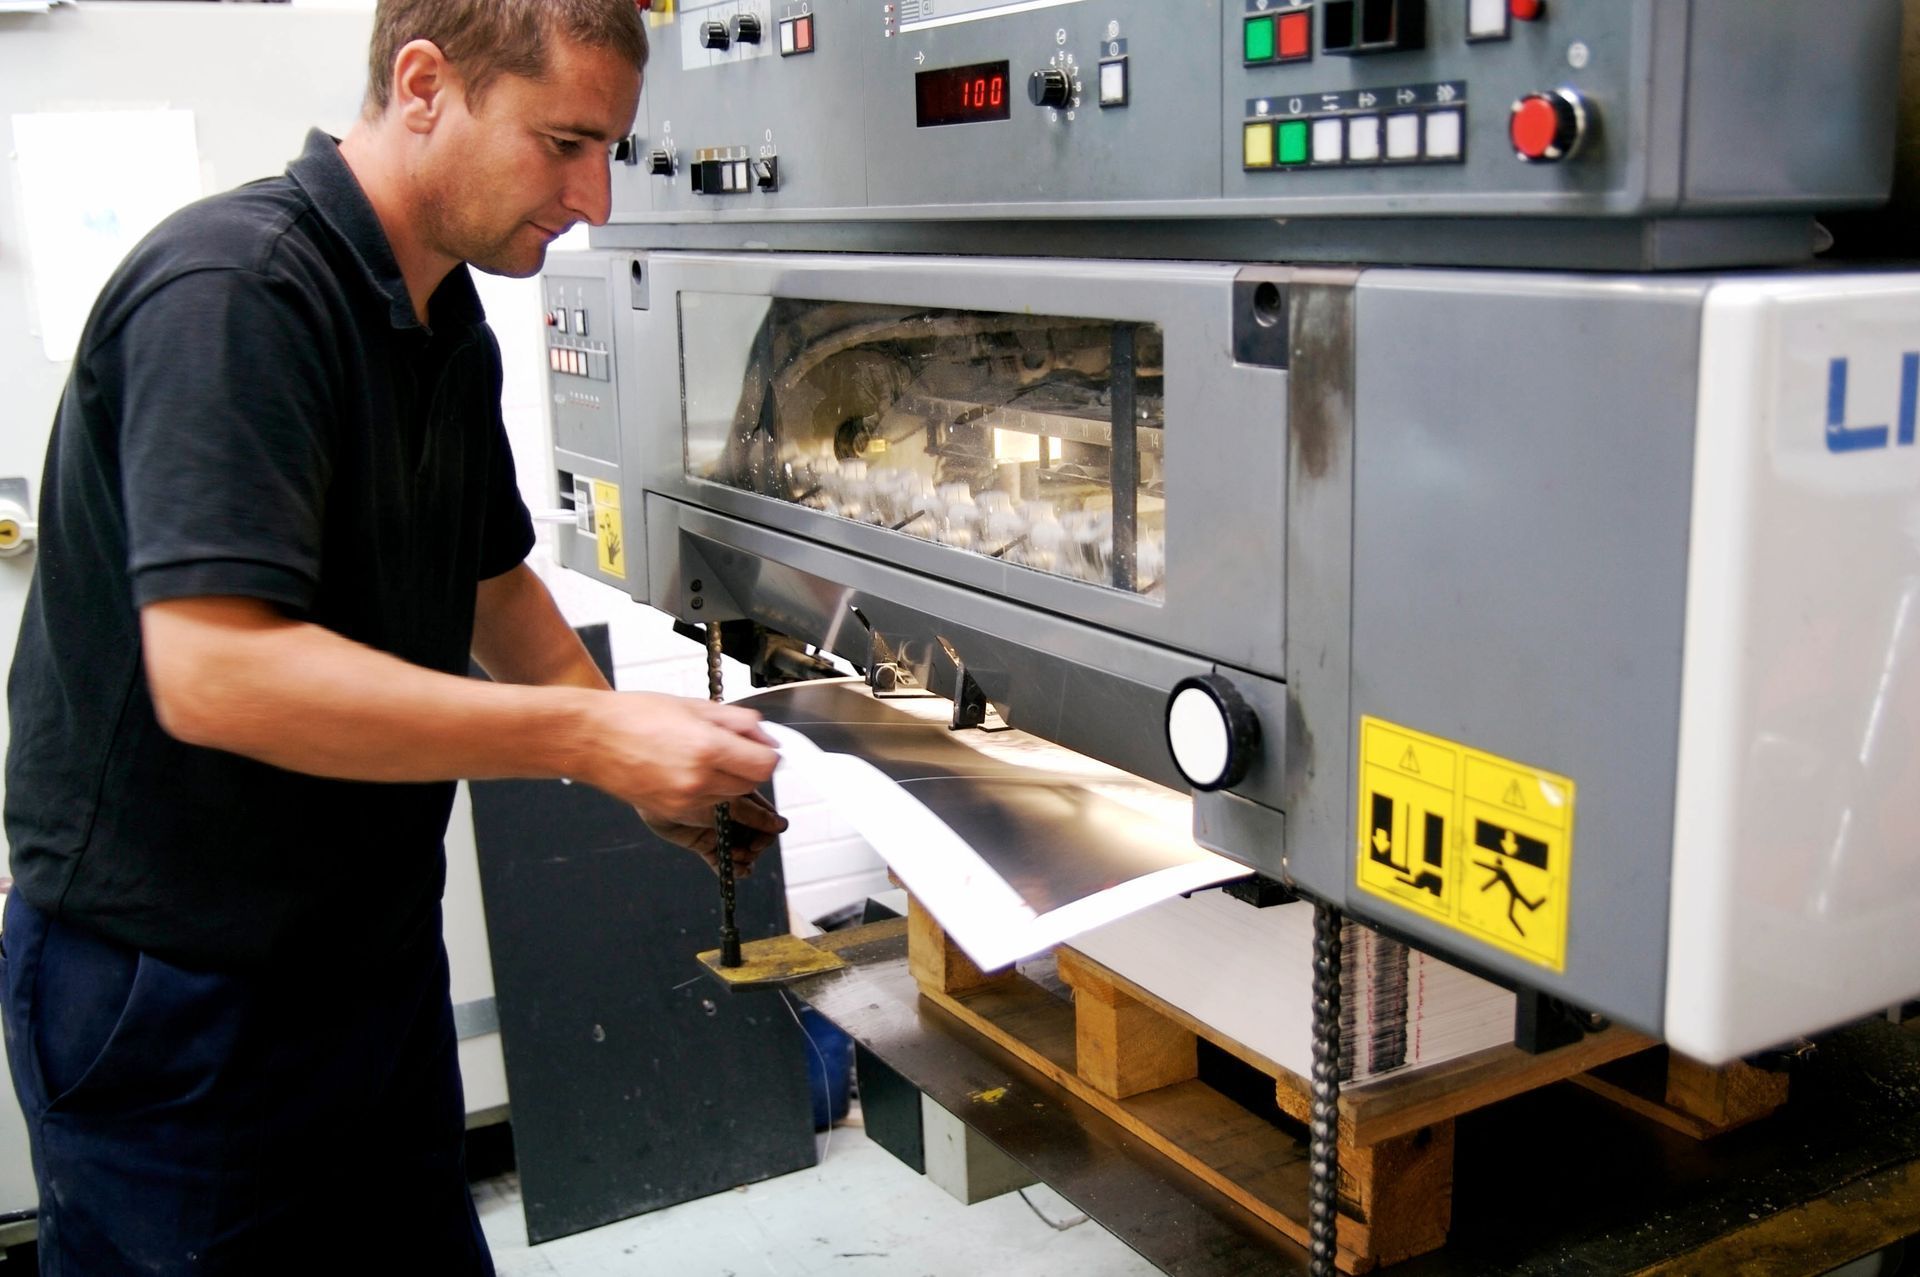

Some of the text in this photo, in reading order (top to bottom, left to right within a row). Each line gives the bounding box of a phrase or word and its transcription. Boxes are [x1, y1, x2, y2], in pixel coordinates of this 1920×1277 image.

[884, 17, 890, 25] 7
[1050, 56, 1056, 66] 4
[1059, 50, 1065, 61] 5
[1067, 54, 1073, 65] 6
[1073, 66, 1079, 77] 7
[963, 77, 1003, 108] 100
[1075, 81, 1082, 93] 8
[1051, 112, 1058, 123] 0
[1082, 423, 1089, 438] 11
[1103, 424, 1112, 441] 12
[1150, 432, 1159, 449] 14
